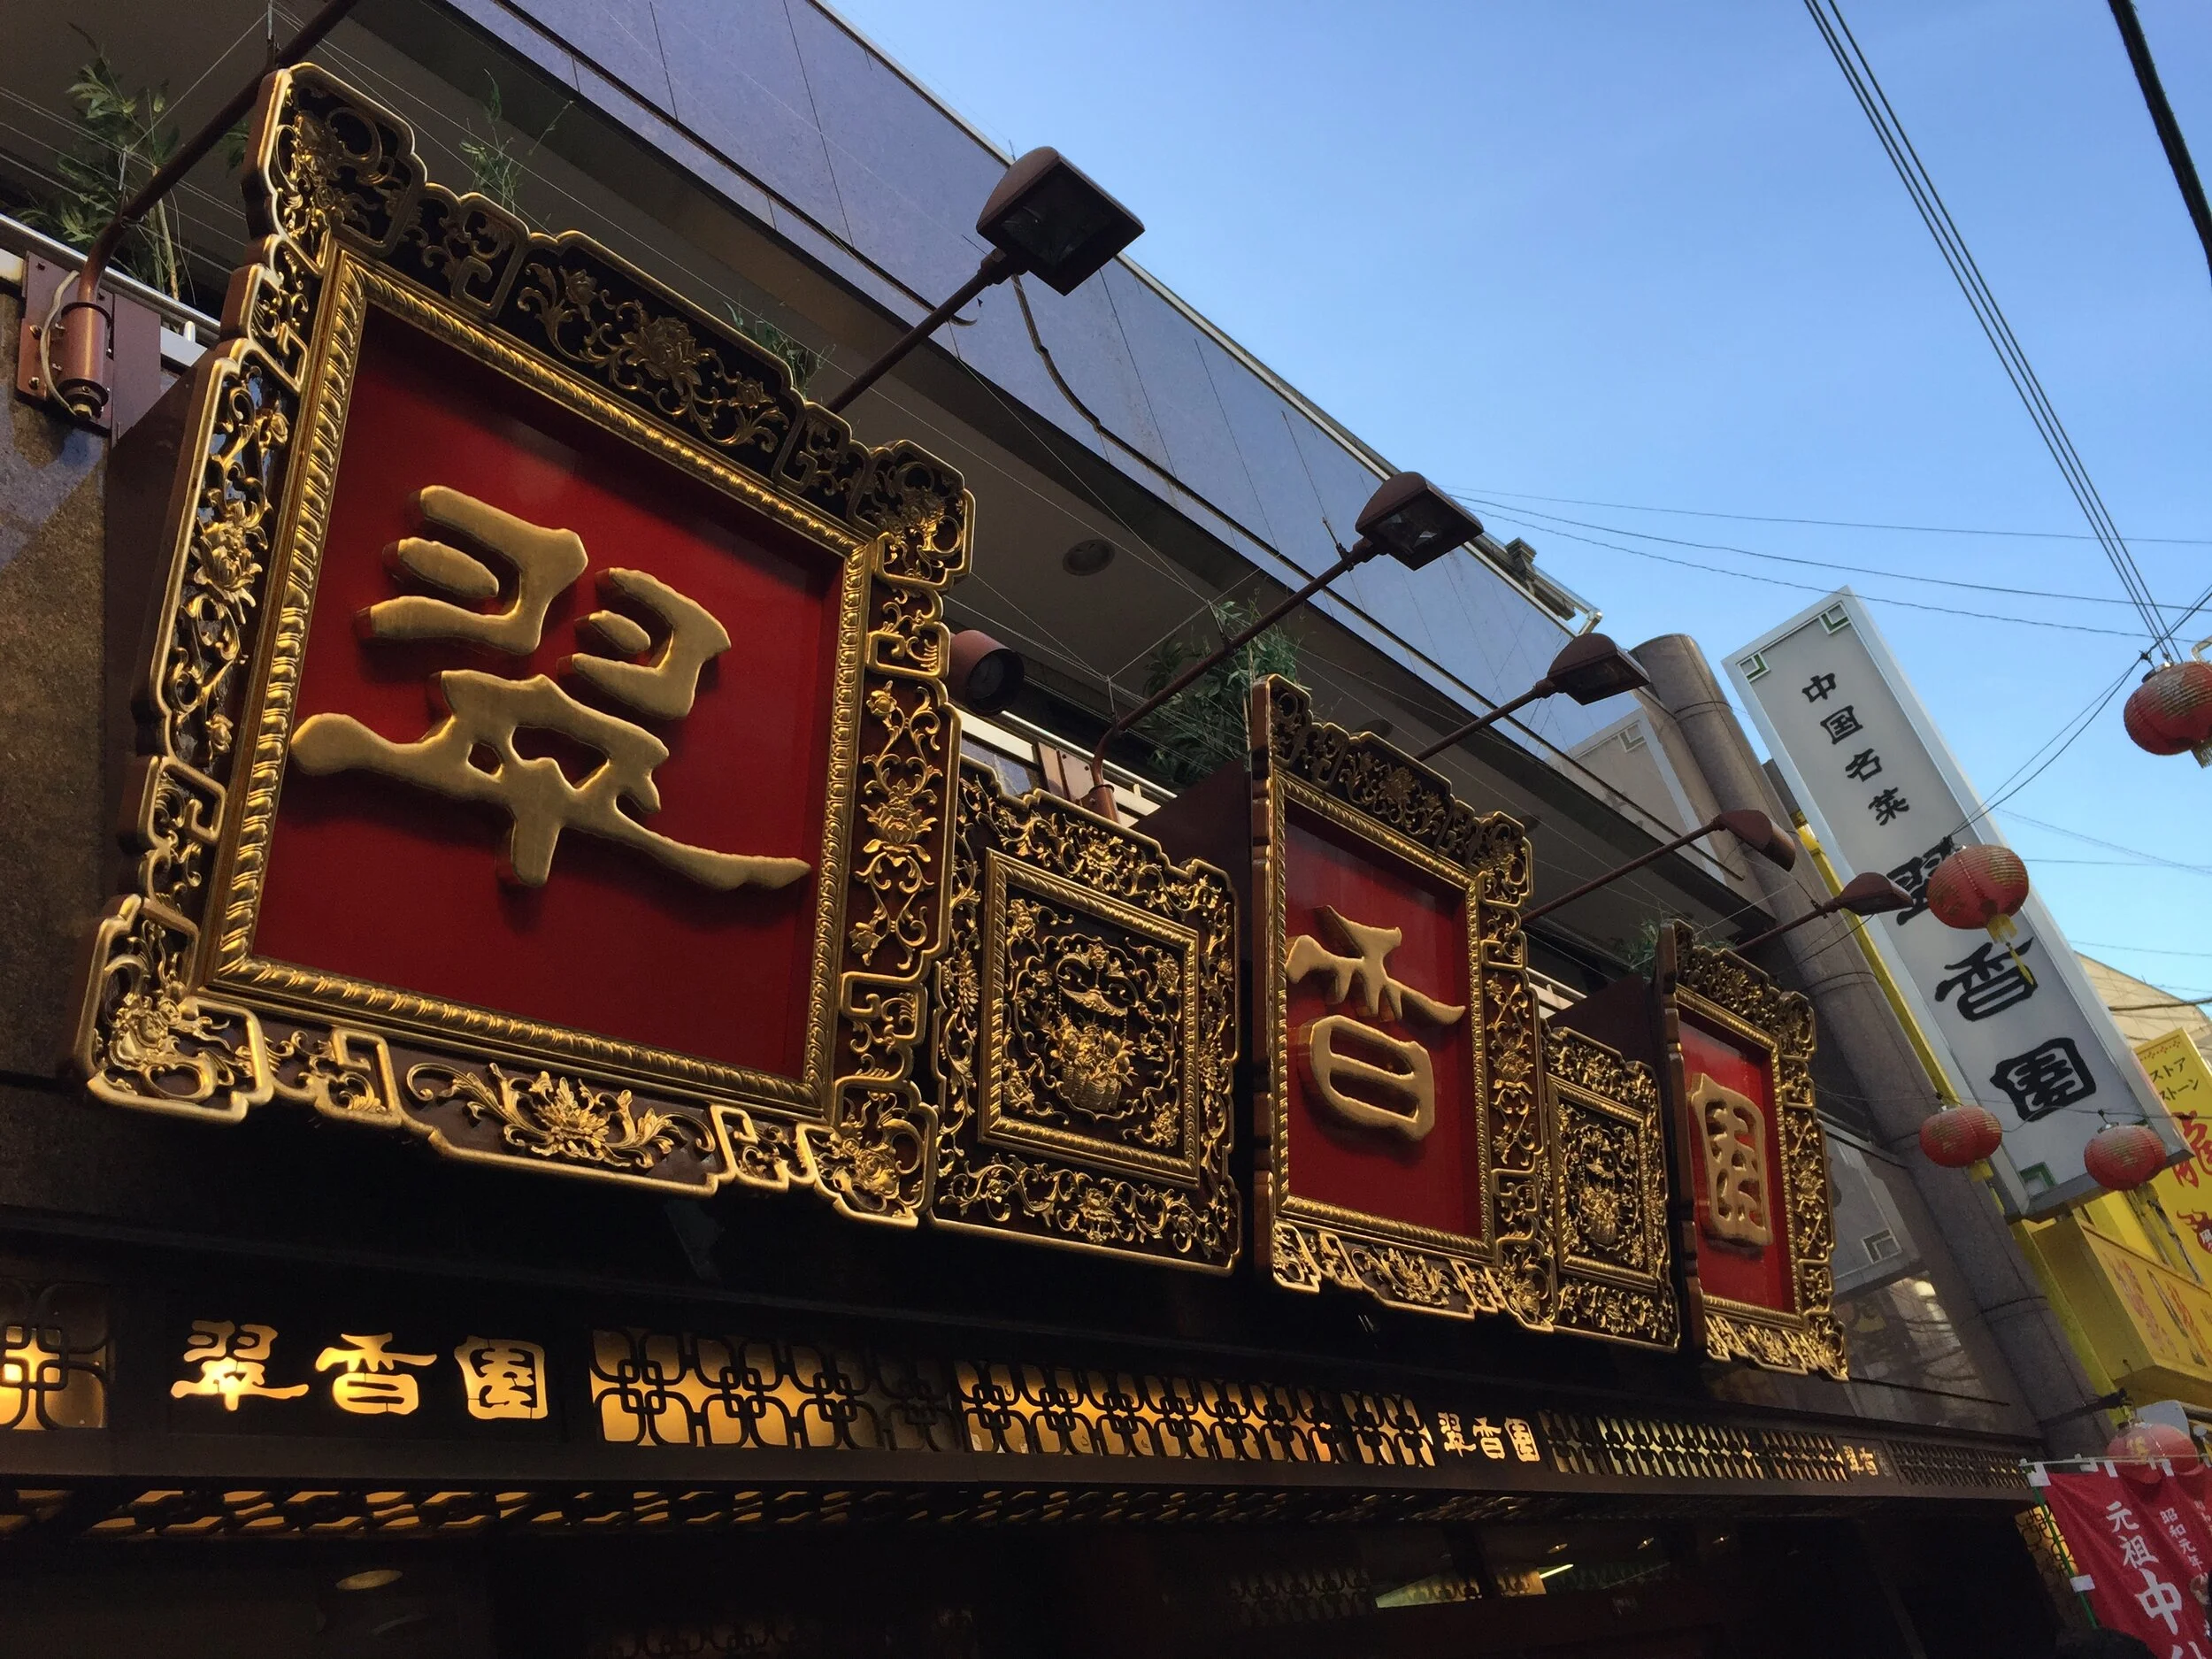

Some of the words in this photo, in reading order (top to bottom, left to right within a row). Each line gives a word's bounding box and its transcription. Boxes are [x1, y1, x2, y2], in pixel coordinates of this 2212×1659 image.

[290, 484, 812, 890] 翠
[1286, 905, 1465, 1141] 香
[1801, 672, 1909, 826] 中国名菜
[171, 1320, 549, 1420] 翠香園
[1437, 1412, 1540, 1462] 翠香園
[2105, 1501, 2208, 1659] 元祖中
[2160, 1507, 2208, 1582] 昭和元年
